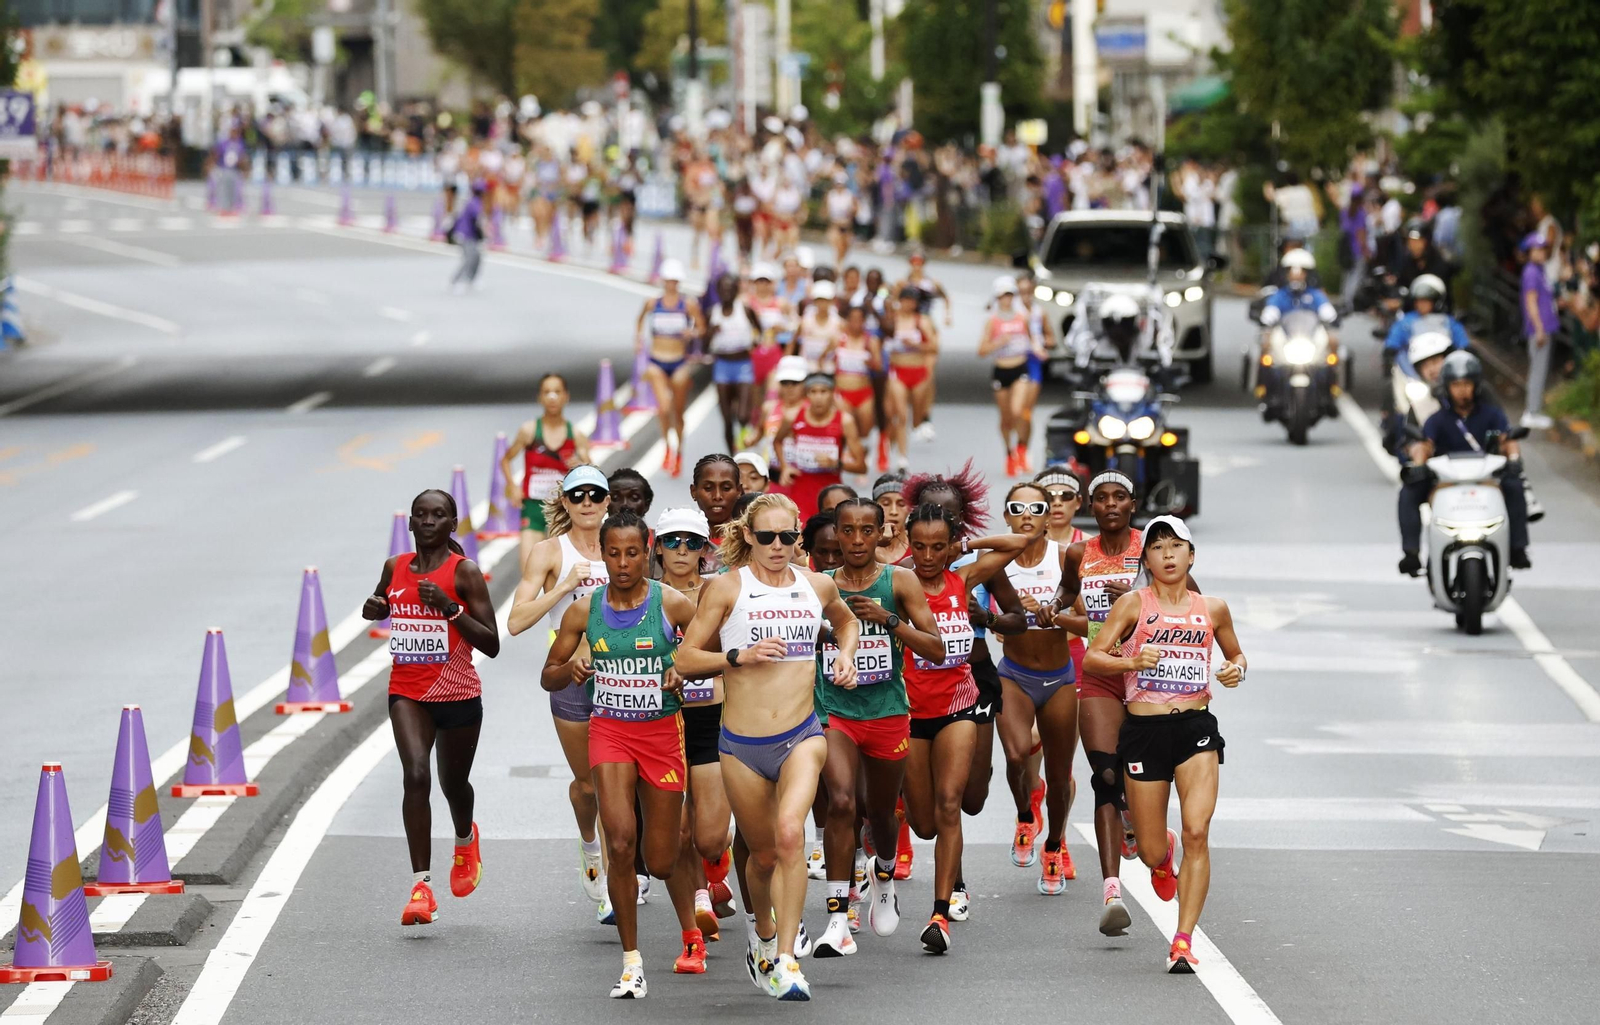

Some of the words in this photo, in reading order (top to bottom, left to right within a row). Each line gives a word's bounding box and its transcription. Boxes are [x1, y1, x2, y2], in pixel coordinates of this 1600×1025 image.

[576, 468, 598, 478] USA
[748, 610, 816, 620] HONDA
[391, 622, 446, 633] HONDA
[1146, 629, 1206, 644] JAPAN
[390, 637, 445, 651] CHUMBA
[1159, 649, 1206, 661] ONDA
[595, 674, 659, 688] HONDA
[597, 690, 658, 708] KETEMA
